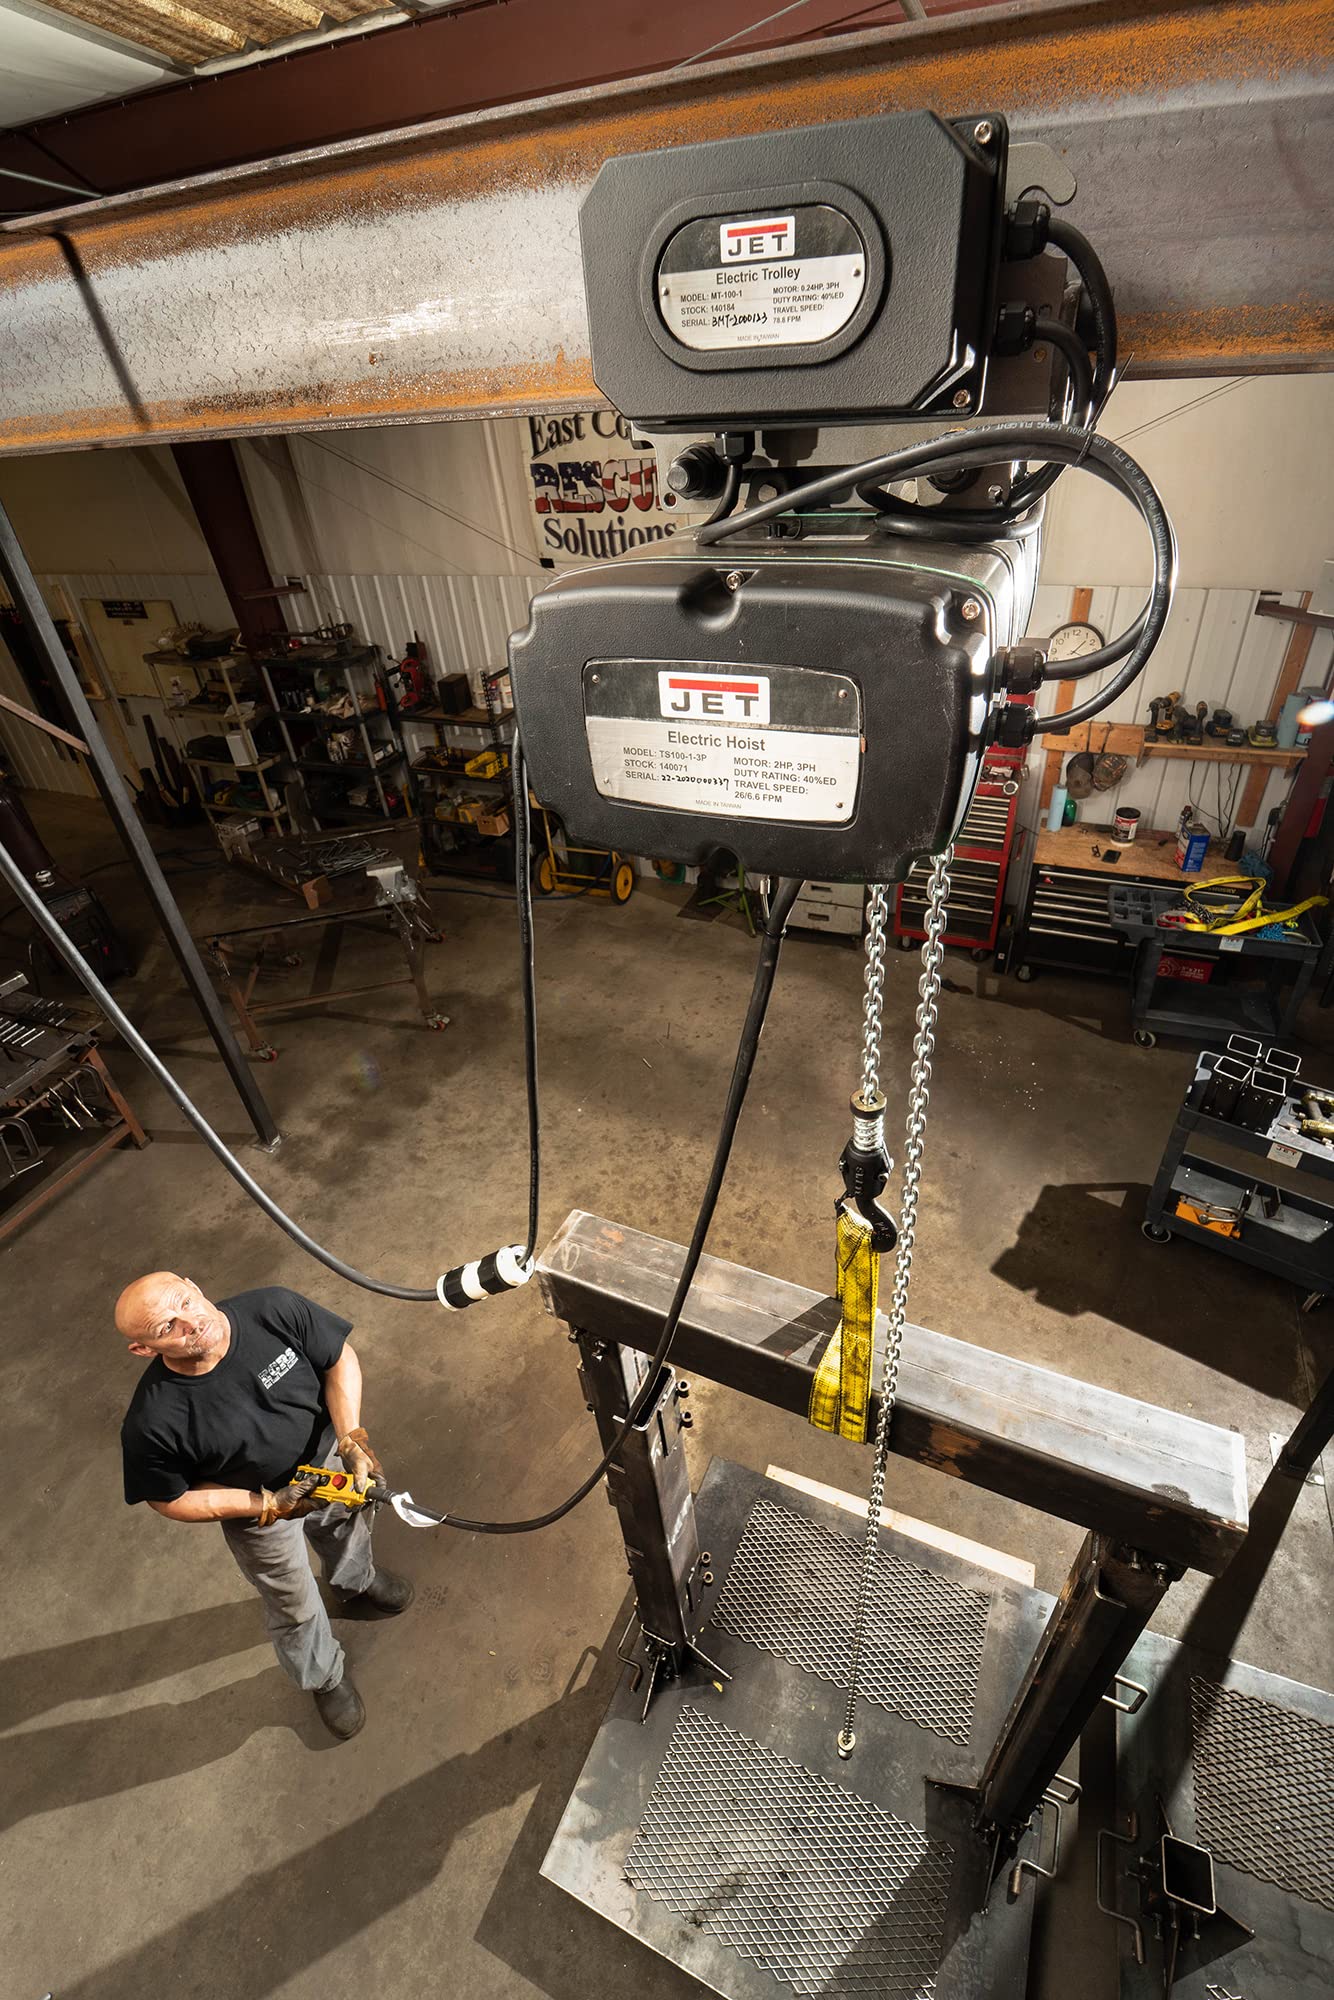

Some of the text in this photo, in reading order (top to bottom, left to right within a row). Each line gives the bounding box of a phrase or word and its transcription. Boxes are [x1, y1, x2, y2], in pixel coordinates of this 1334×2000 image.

[728, 234, 787, 256] JET
[717, 267, 800, 284] Electric Trolley
[681, 290, 742, 302] MODEL: MT-100-1
[773, 286, 799, 294] MOTOR:
[773, 296, 790, 304] DUTY
[792, 294, 819, 302] RATING:
[681, 304, 735, 315] STOCK: 140184
[800, 303, 824, 311] SPEED:
[682, 319, 710, 327] SERIAL:
[529, 413, 585, 459] East
[531, 458, 663, 513] RESCU
[671, 692, 758, 717] JET
[668, 731, 765, 751] Electric Hoist
[623, 748, 707, 761] MODEL: TS100-1-3P
[624, 760, 688, 772] STOCK: 140071
[734, 757, 816, 772] MOTOR: 2HP, 3PH
[626, 771, 659, 781] SERIAL:
[734, 768, 836, 786] DUTY RATING: 40%ED
[735, 780, 808, 795] TRAVEL SPEED:
[735, 791, 782, 803] 26/6.6 FPM
